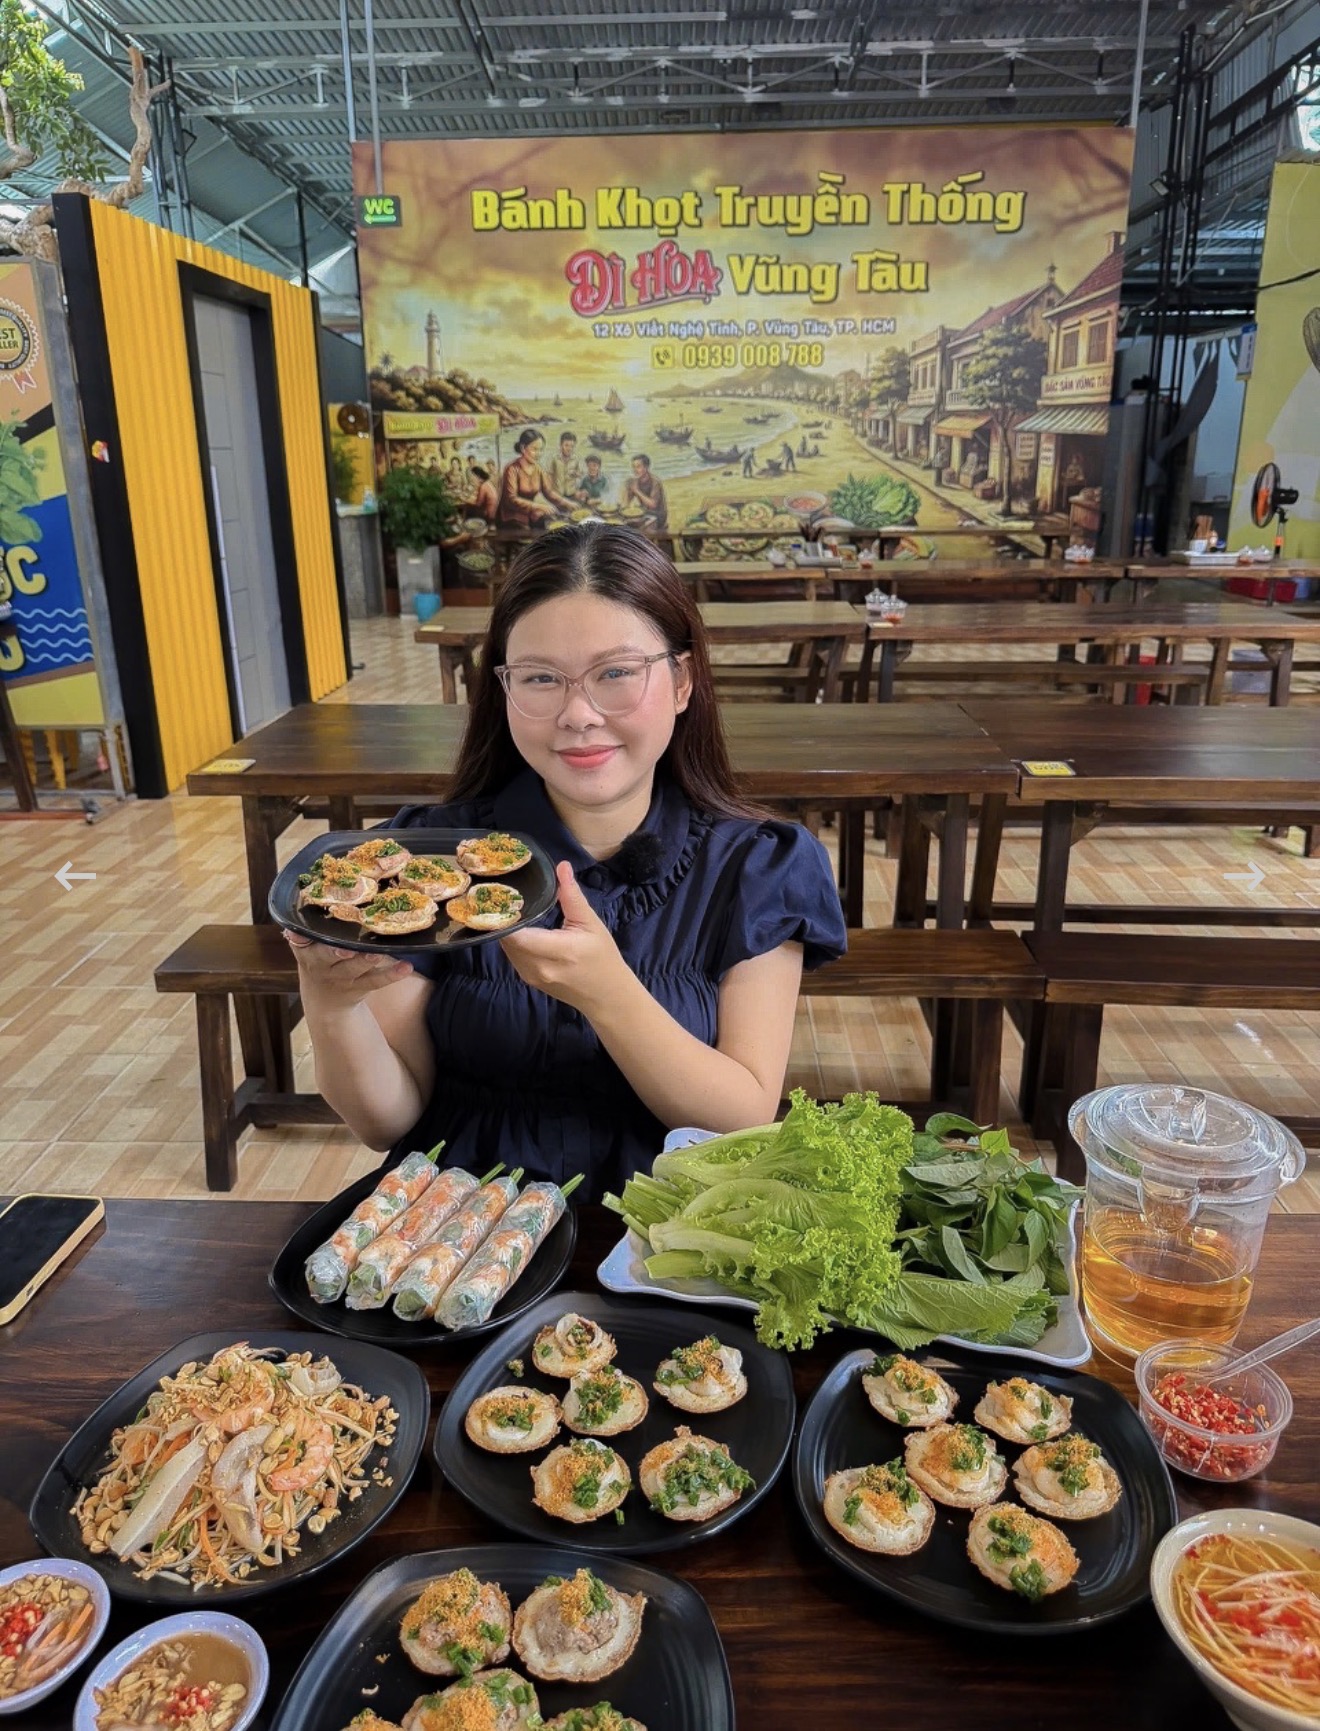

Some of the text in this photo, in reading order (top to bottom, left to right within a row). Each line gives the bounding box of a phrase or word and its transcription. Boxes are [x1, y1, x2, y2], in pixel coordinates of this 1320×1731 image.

[364, 198, 395, 215] WC
[471, 171, 1025, 236] Bánh Khọt Truyền Thống
[631, 240, 723, 304] HOA
[728, 254, 840, 303] Vũng
[0, 328, 15, 341] ST
[593, 322, 611, 338] 12
[746, 320, 761, 335] P.
[861, 317, 896, 334] HCM
[683, 343, 824, 368] 0939 008 788
